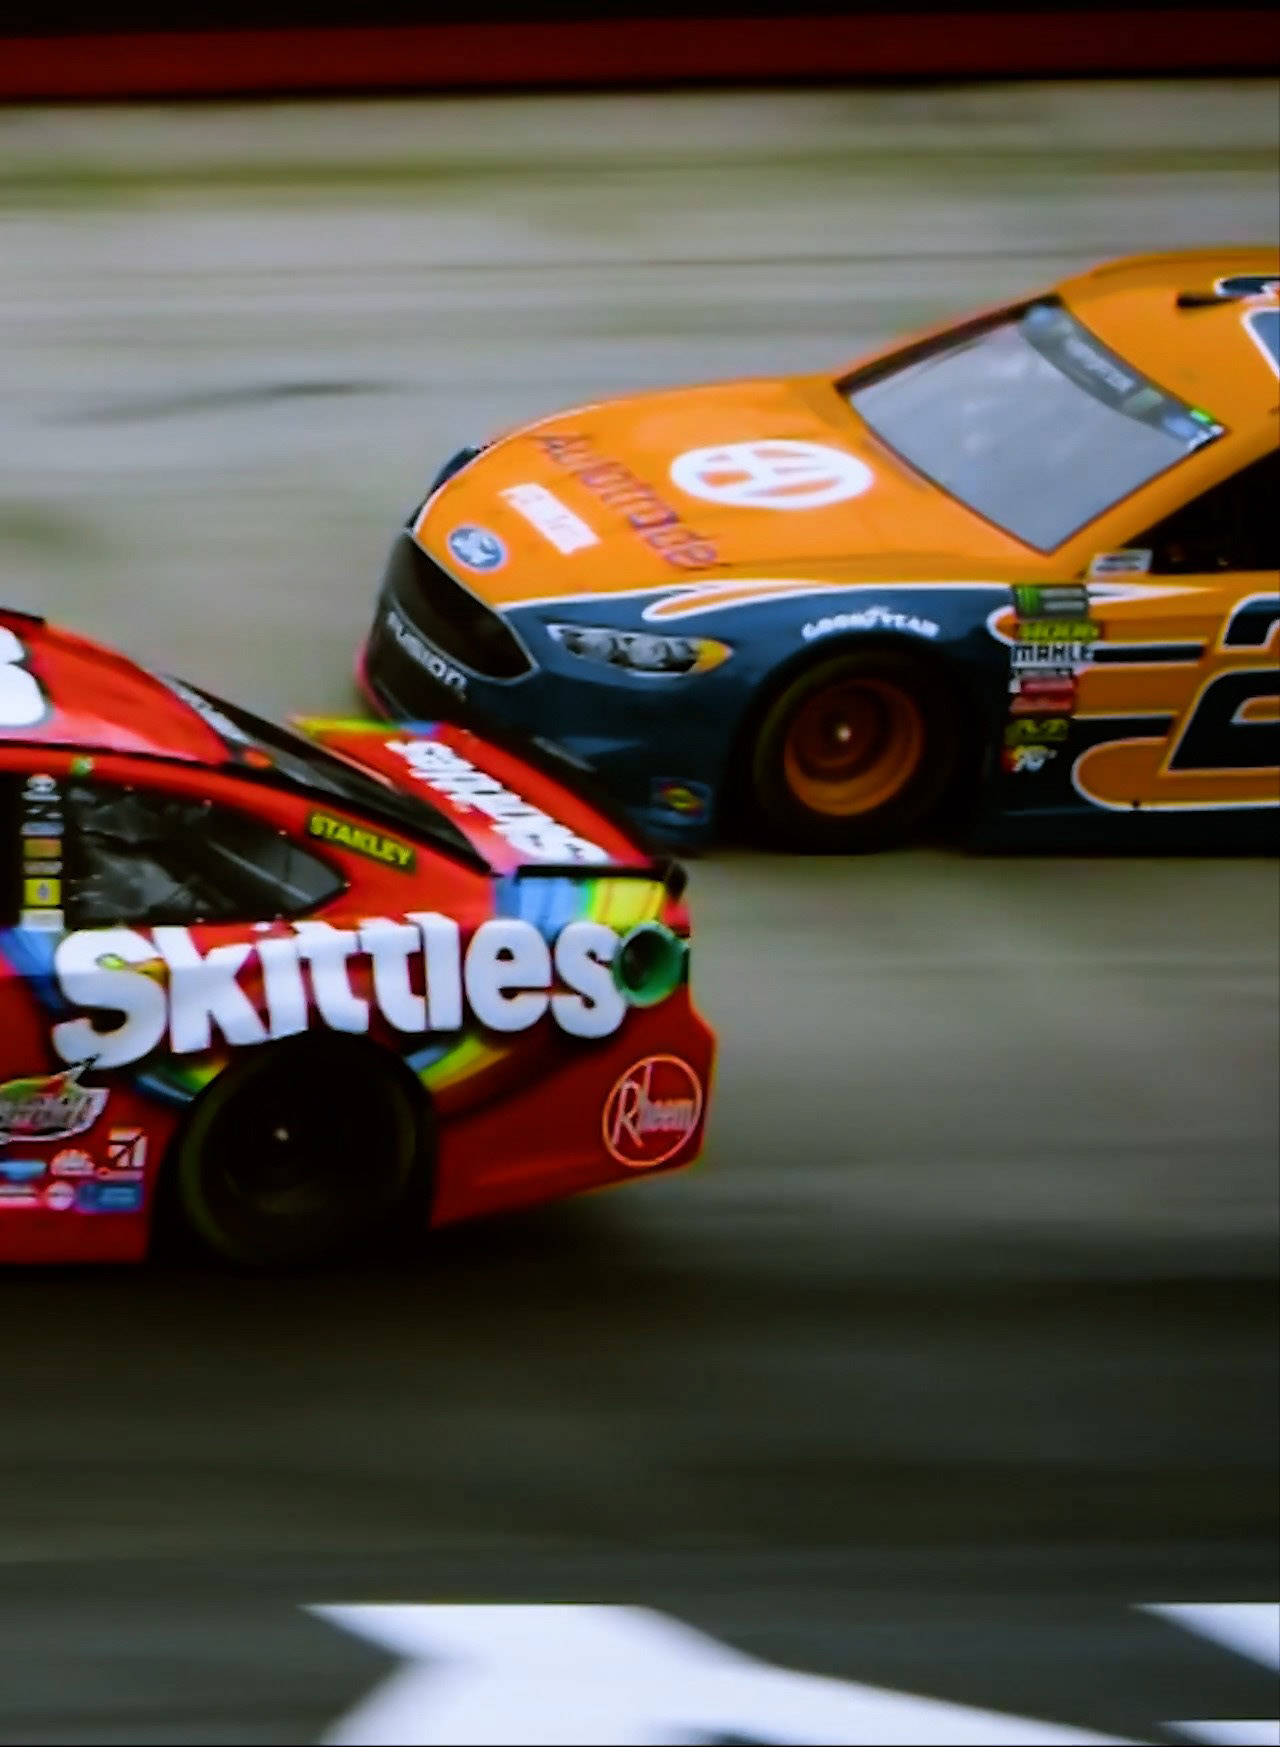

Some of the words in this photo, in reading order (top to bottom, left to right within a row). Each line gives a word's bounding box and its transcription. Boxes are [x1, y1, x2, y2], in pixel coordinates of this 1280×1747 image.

[310, 812, 413, 867] STANLEY
[52, 911, 630, 1070] Skittles
[612, 1062, 694, 1148] Rheem
